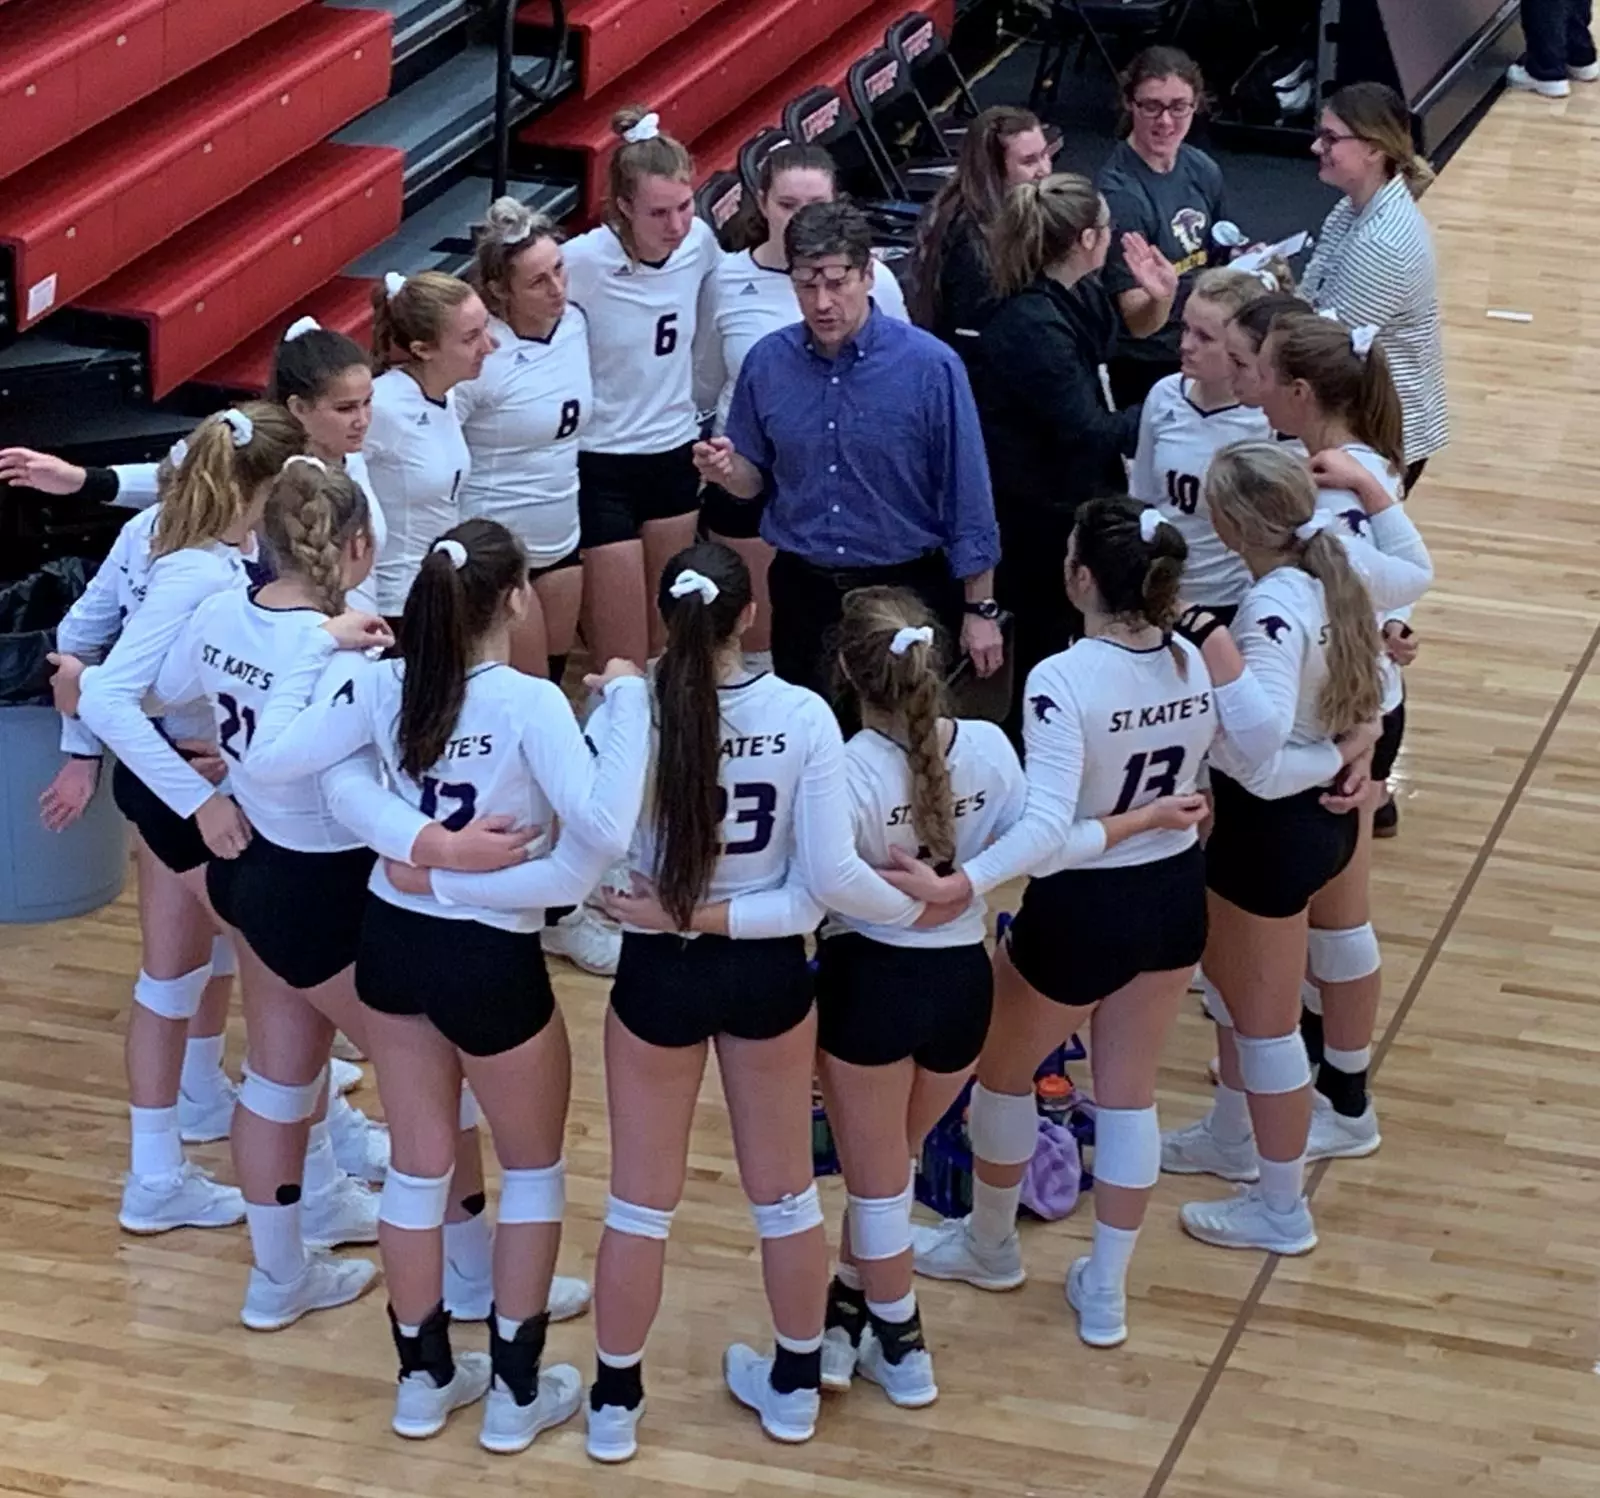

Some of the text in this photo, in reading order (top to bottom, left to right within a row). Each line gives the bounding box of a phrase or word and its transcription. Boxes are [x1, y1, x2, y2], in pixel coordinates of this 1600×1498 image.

[655, 313, 677, 356] 6
[555, 399, 580, 440] 8
[1166, 469, 1200, 514] 10
[222, 653, 275, 691] KATE'S
[217, 691, 257, 763] 21
[1138, 692, 1210, 729] KATE'S
[448, 734, 493, 760] TE'S
[720, 732, 787, 759] ATE'S
[1109, 745, 1186, 816] 13
